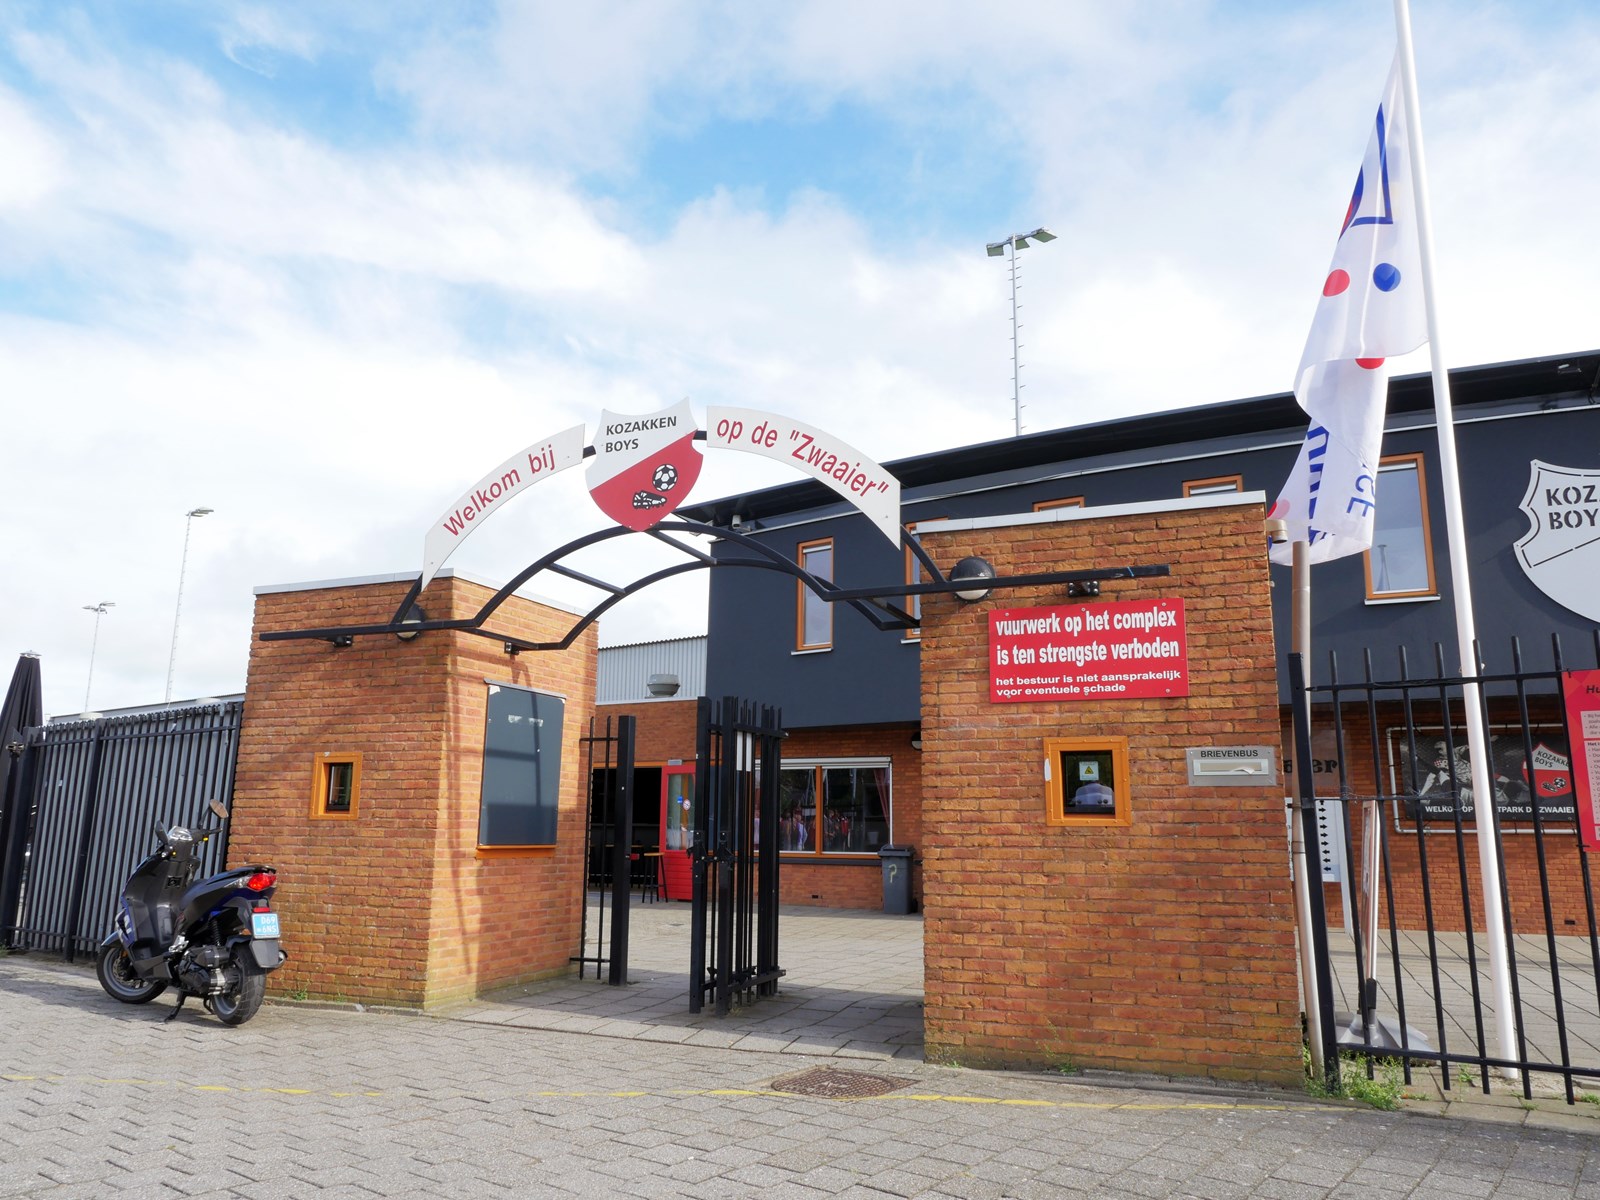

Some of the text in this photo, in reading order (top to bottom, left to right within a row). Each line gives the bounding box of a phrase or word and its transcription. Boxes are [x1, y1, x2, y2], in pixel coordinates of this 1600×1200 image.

[606, 416, 677, 436] KOZAKKEN
[605, 438, 639, 453] BOYS
[716, 418, 890, 497] op de "Zwaaier"
[442, 443, 556, 537] Welkom bij
[1545, 484, 1600, 507] KOZ
[1548, 508, 1599, 530] BOY
[995, 606, 1177, 637] vuurwerk op het complex
[996, 636, 1180, 667] is ten strengste verboden
[996, 670, 1182, 686] het bestuur is niet aansprakelijk
[996, 683, 1126, 696] voor eventuele schade
[1586, 685, 1600, 694] Hu
[1200, 749, 1259, 758] BRIEVENBUS
[1534, 756, 1554, 768] BOYS
[1424, 805, 1454, 813] WELKO
